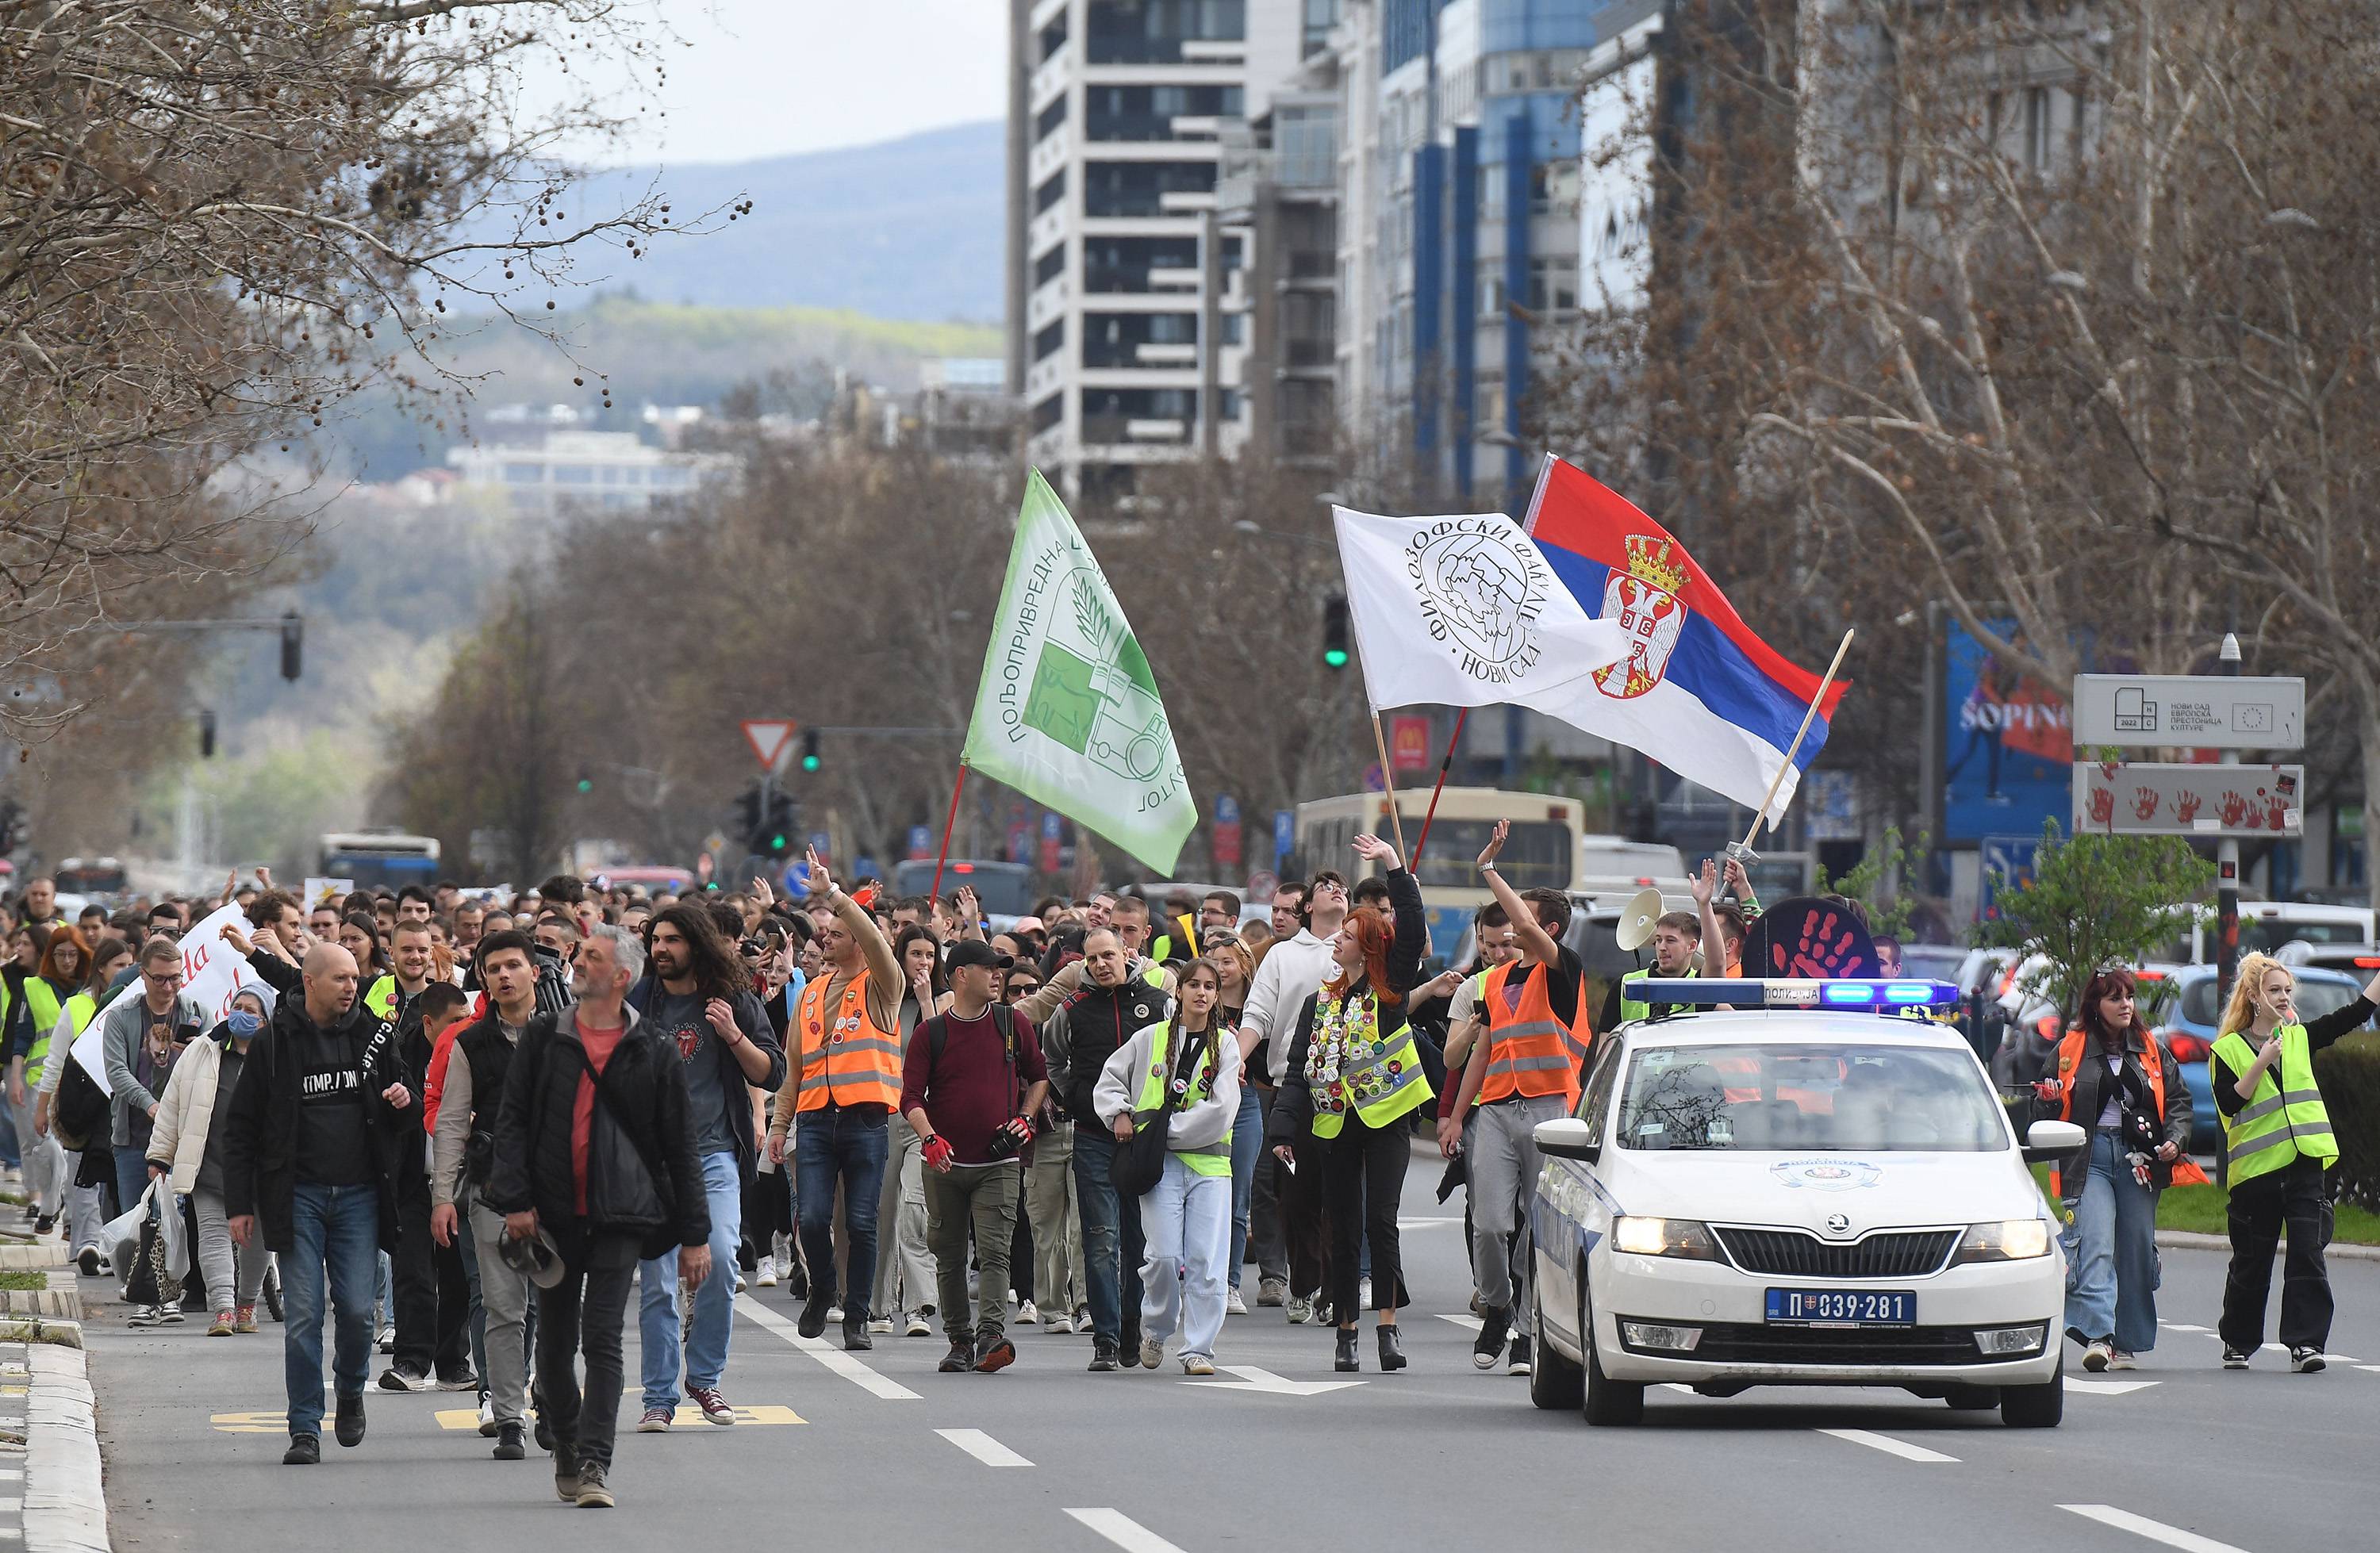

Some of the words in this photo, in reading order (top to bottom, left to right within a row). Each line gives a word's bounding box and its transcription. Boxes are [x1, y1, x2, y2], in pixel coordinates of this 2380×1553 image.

[1000, 540, 1066, 742] ПОЉОПРИВРЕДНА
[1461, 651, 1511, 684] НОВИ
[1510, 644, 1542, 678] САД
[1790, 1293, 1802, 1317] П
